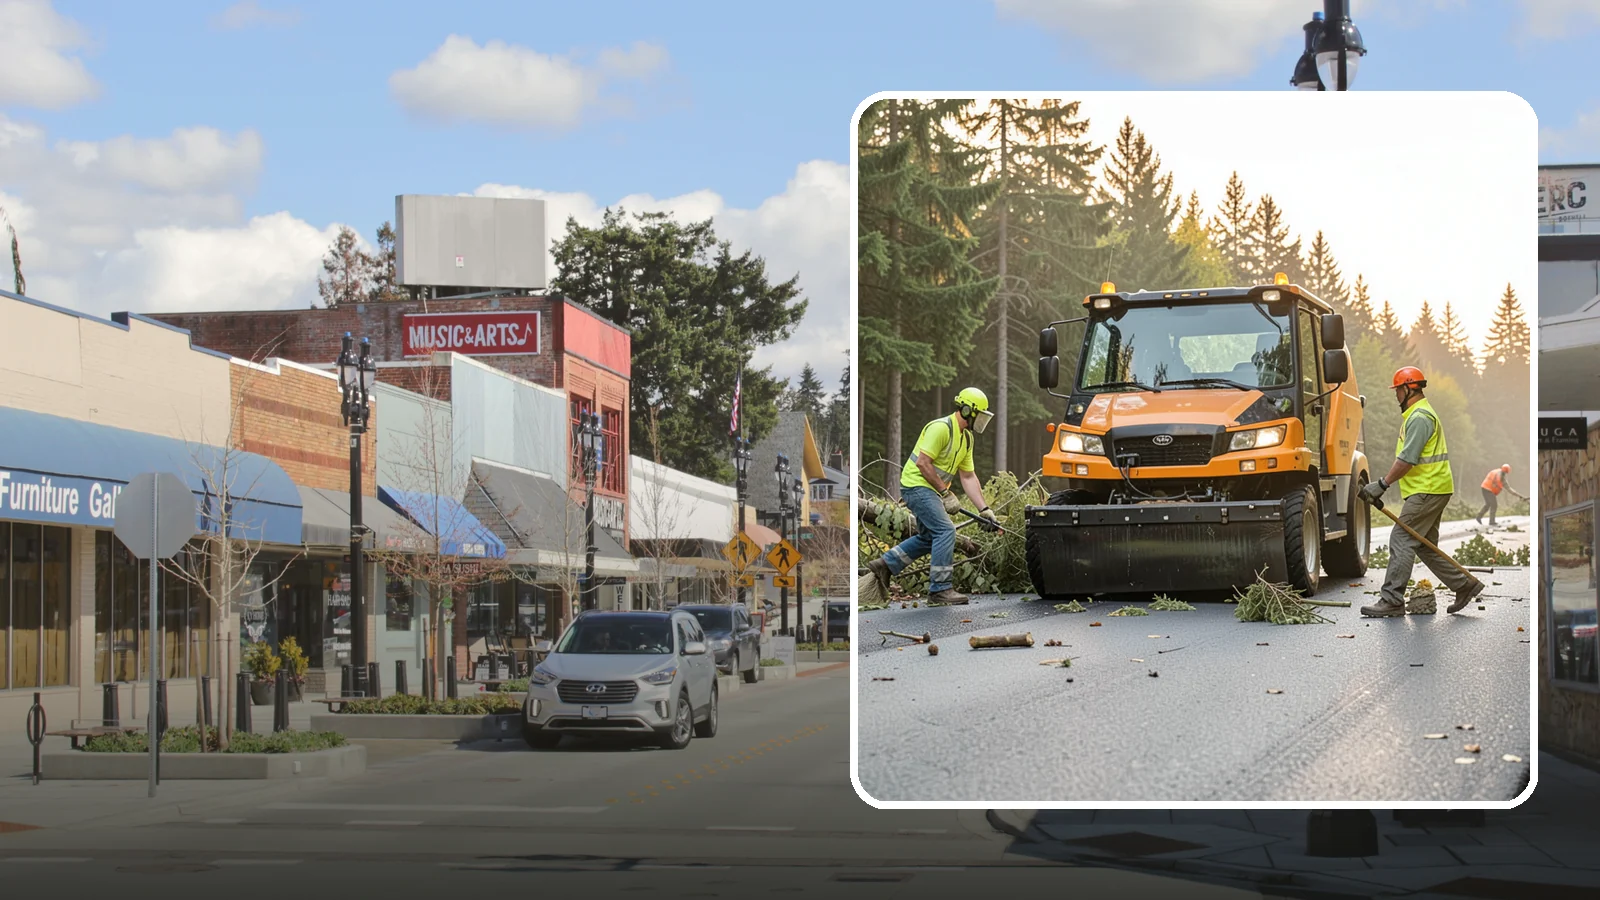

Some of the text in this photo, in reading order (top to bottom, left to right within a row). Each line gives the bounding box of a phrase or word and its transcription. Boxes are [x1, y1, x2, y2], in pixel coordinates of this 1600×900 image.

[409, 323, 519, 348] MUSIC&ARTS
[0, 471, 122, 519] Furniture Gal
[453, 563, 479, 574] SUSHI
